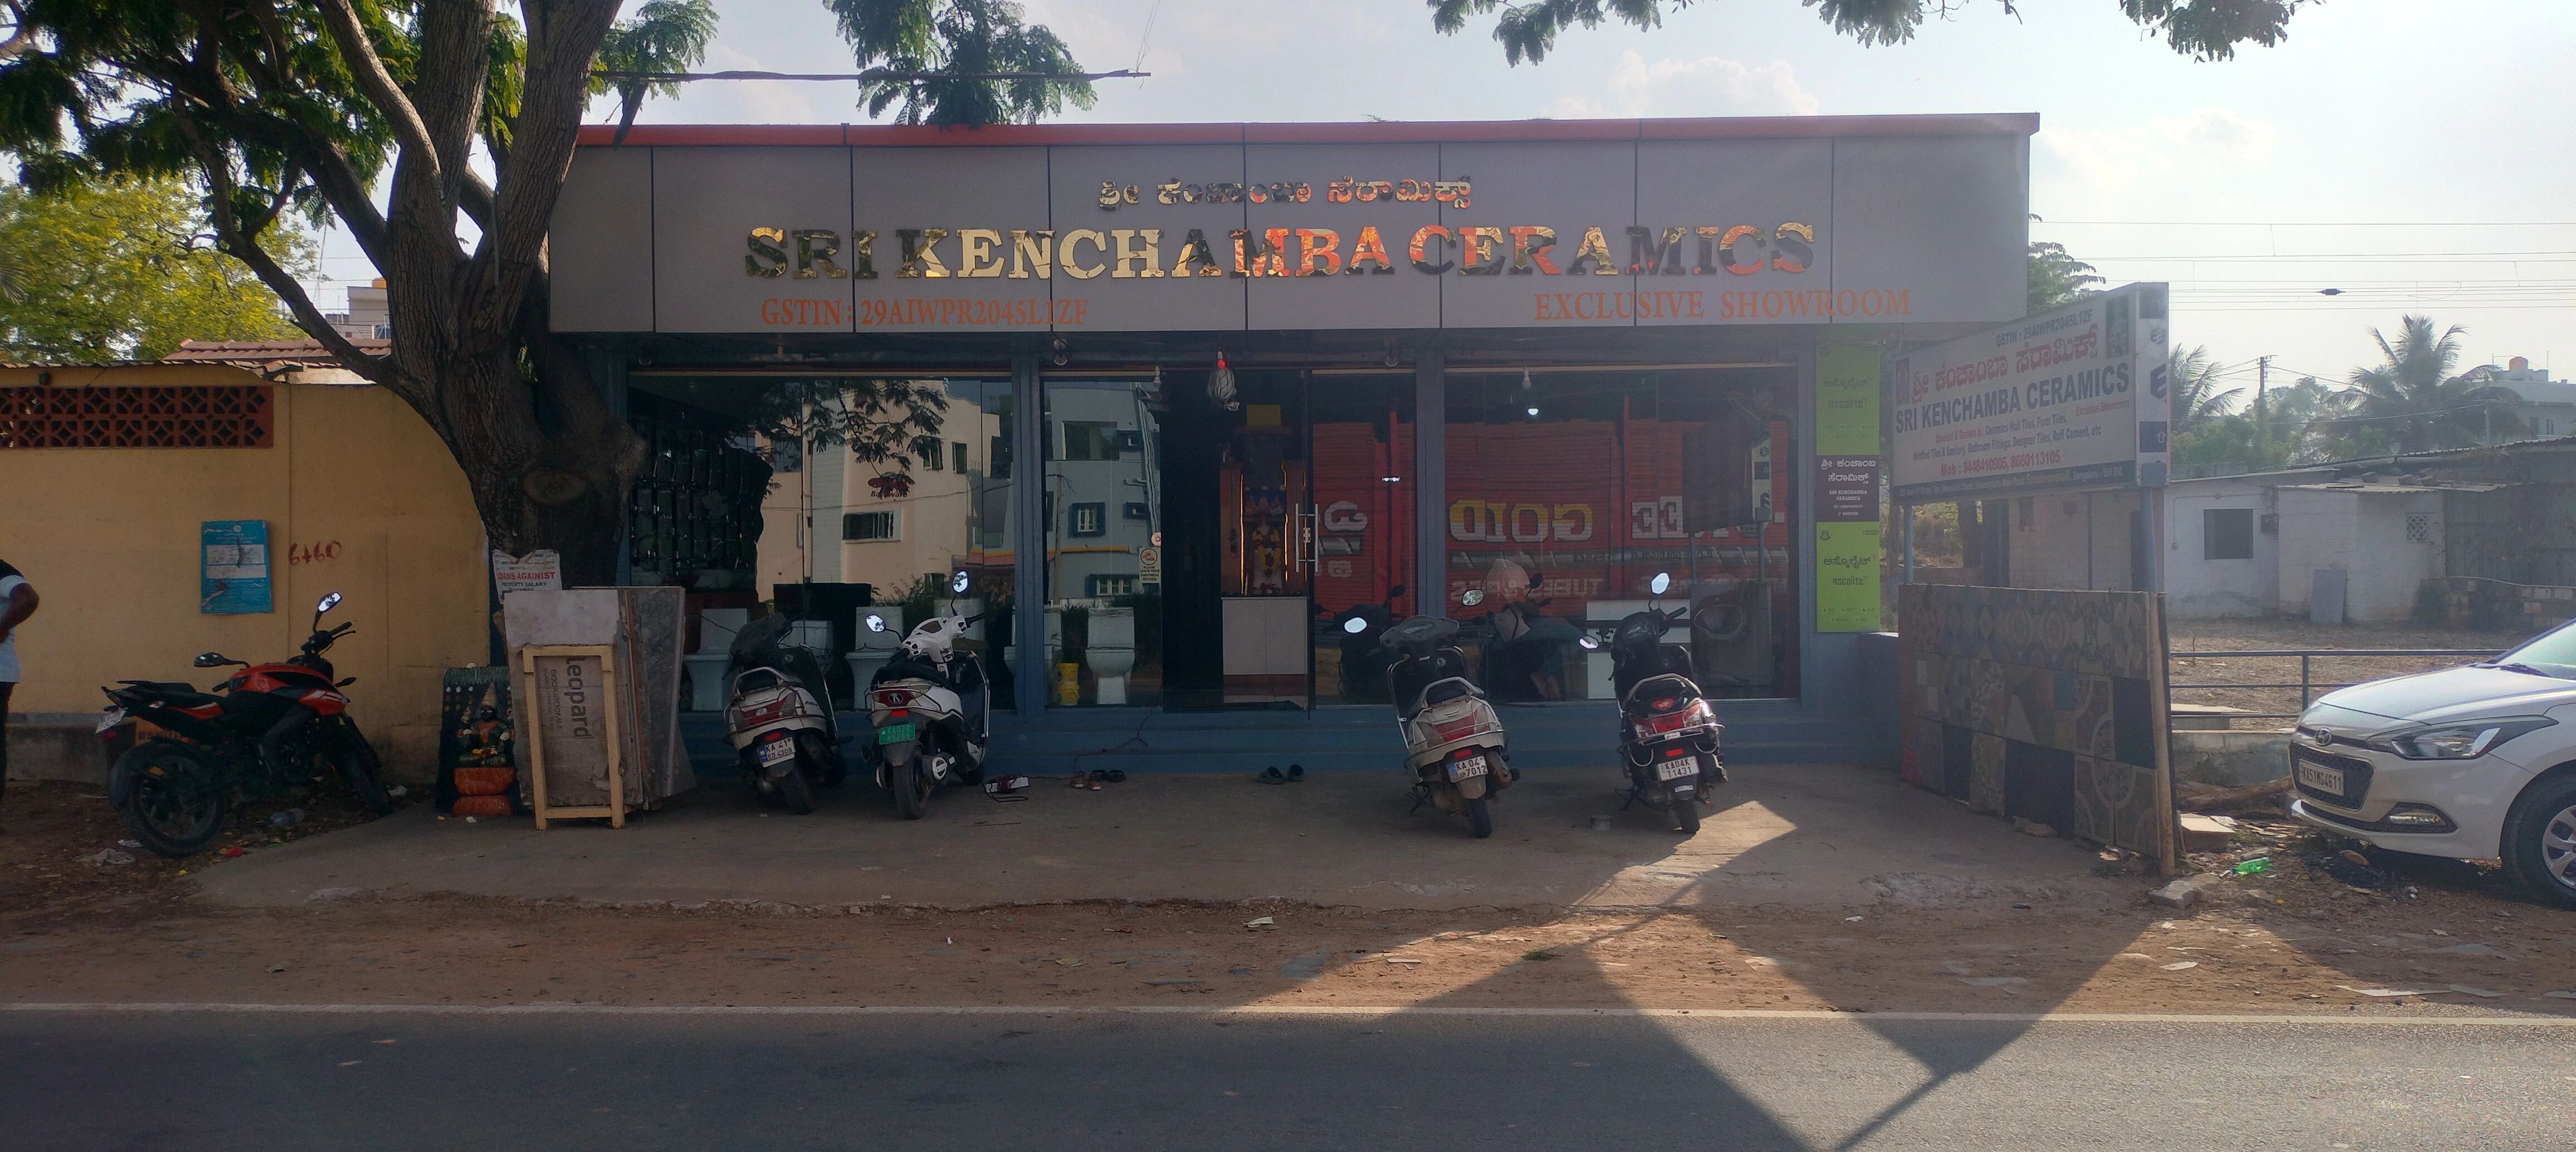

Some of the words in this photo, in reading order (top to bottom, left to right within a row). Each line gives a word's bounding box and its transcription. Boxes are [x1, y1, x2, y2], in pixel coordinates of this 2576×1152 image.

[1099, 178, 1140, 212] ಶ್ರೀ
[745, 227, 879, 279] SRI
[895, 225, 1397, 280] KENCHAMBA
[1409, 222, 1814, 276] CERAMICS
[761, 297, 842, 326] GSTIN
[1533, 290, 1706, 321] EXCLUSIVE
[1720, 287, 1913, 319] SHOWROOM
[1996, 331, 2017, 348] GSTIN
[1911, 371, 1929, 404] ಶ್ರೀ
[1896, 408, 1917, 433] SRI
[1922, 386, 2021, 429] KENCHAMBA
[2026, 362, 2129, 410] CERAMICS
[2037, 417, 2052, 431] Floor
[1820, 458, 1833, 470] ಶ್ರೀ
[1940, 463, 1957, 476] Mob
[765, 744, 776, 753] KA
[1455, 762, 1467, 770] KA
[1468, 758, 1480, 767] 04
[1665, 758, 1690, 770] KA04K
[1666, 766, 1692, 778] T1431
